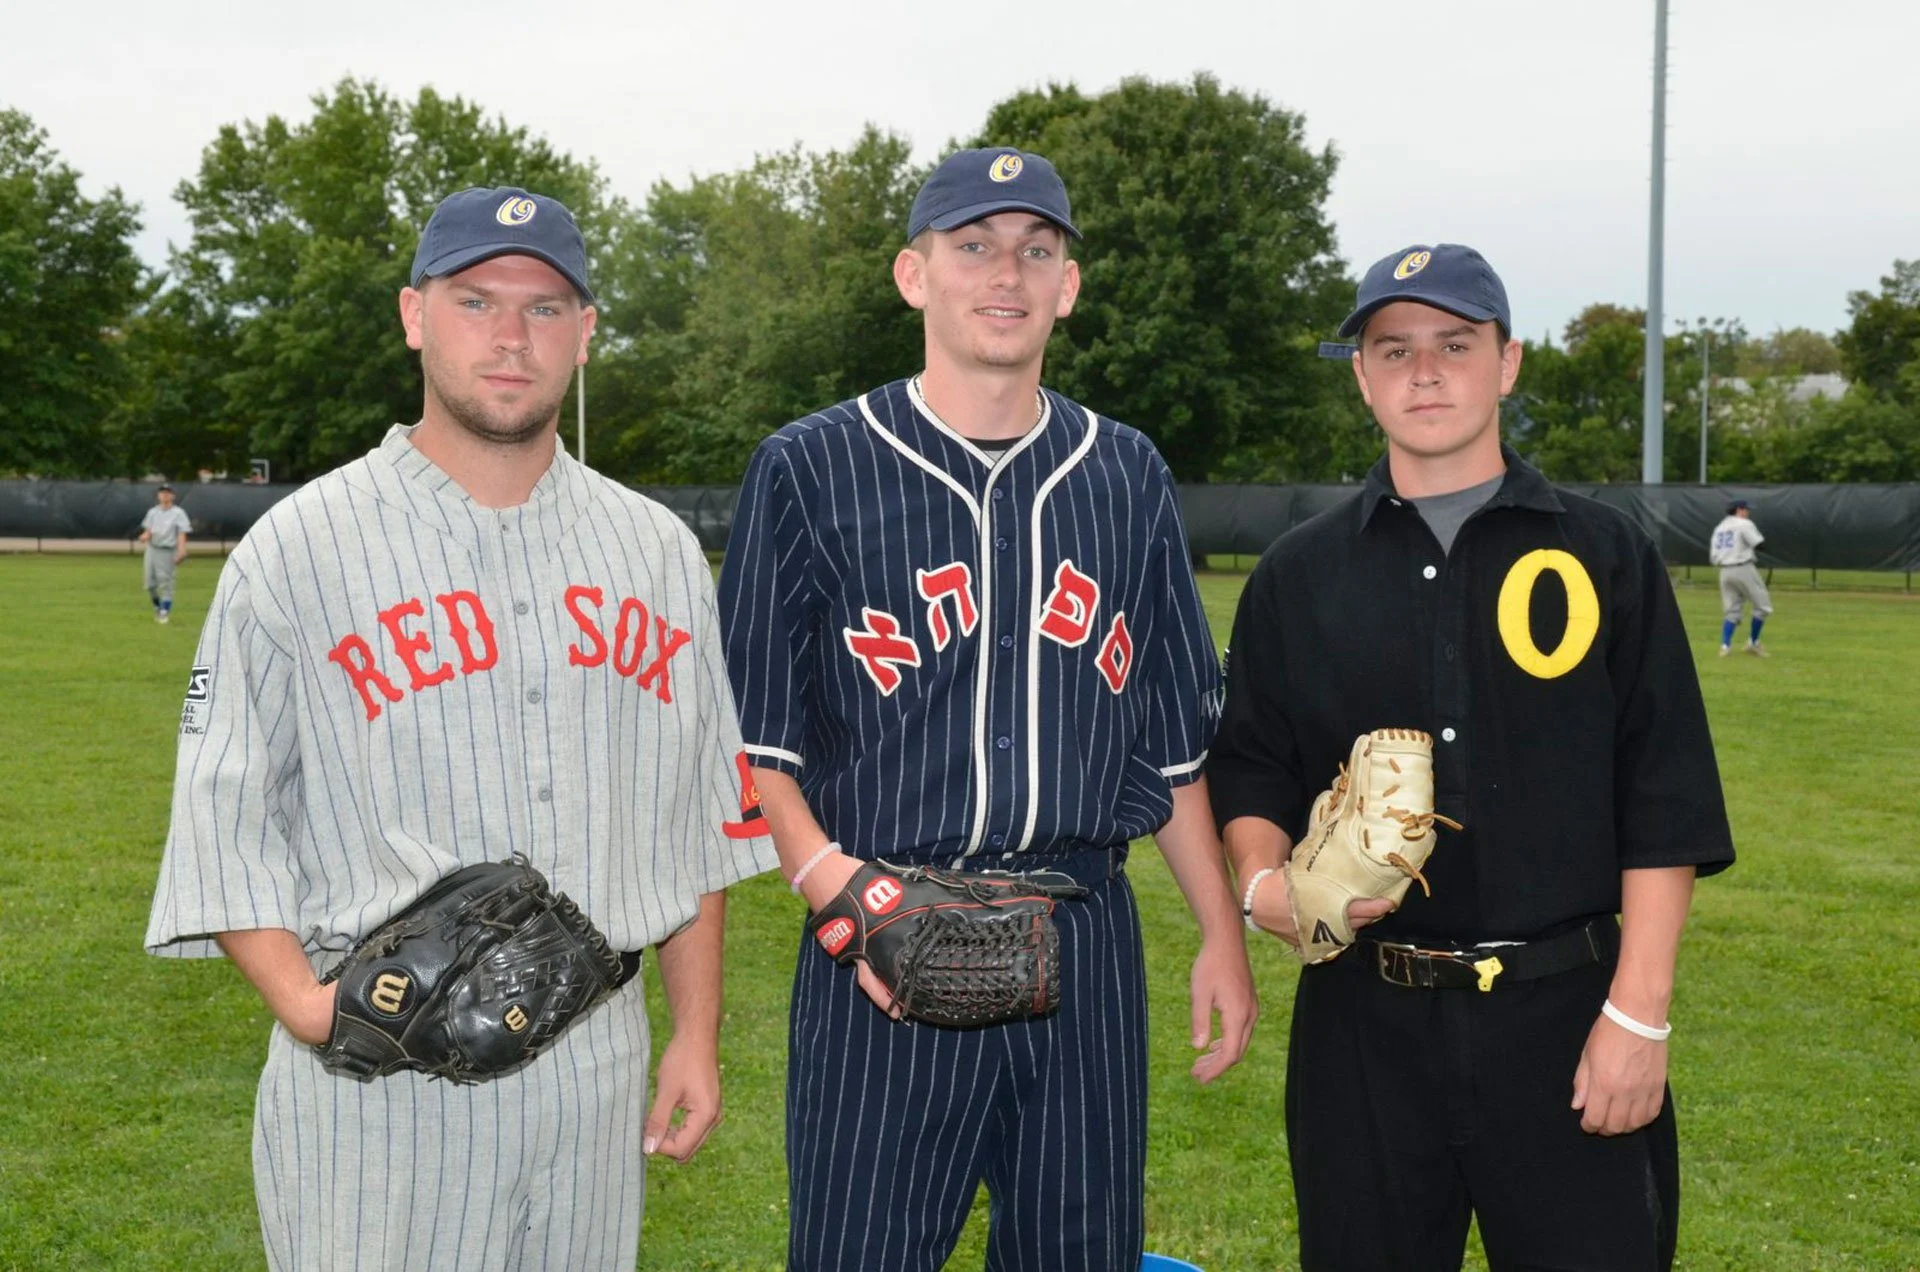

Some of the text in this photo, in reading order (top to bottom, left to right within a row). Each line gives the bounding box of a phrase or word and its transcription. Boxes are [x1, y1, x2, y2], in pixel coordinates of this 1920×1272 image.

[1714, 530, 1735, 550] 32
[329, 586, 691, 721] RED SOX
